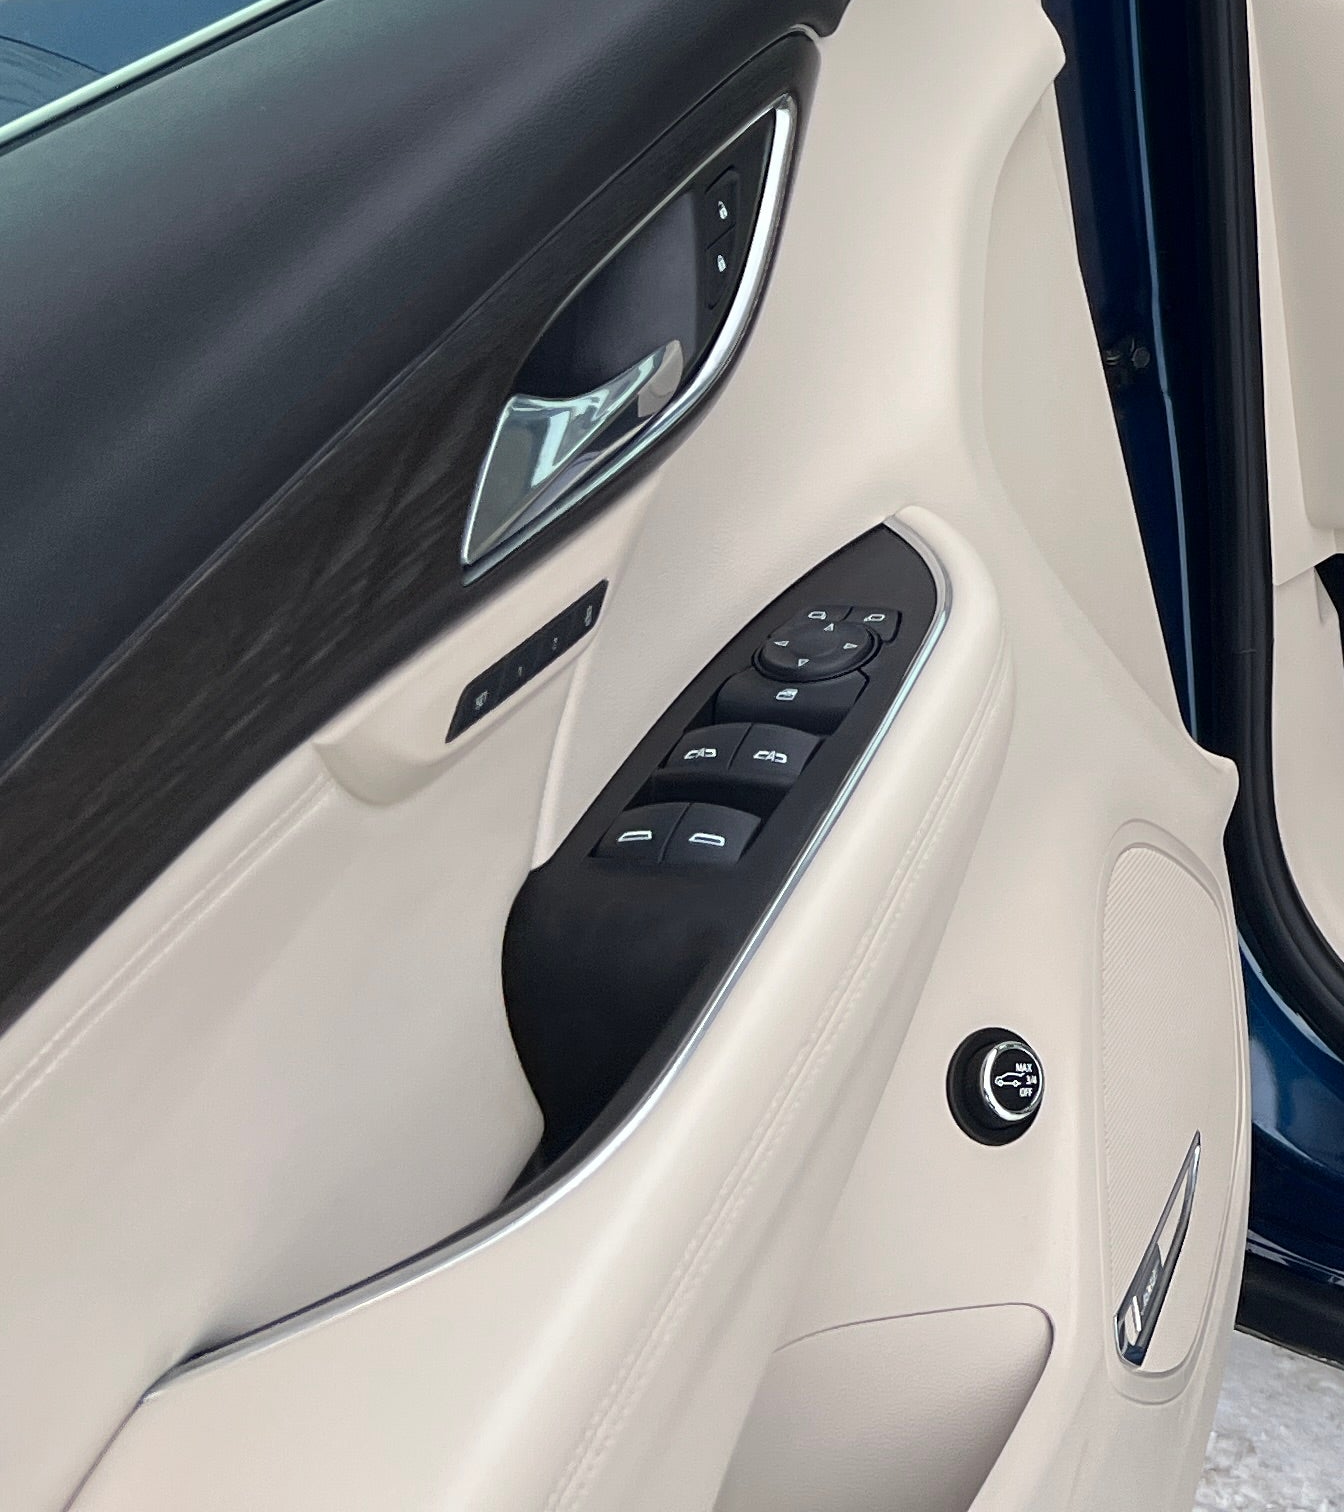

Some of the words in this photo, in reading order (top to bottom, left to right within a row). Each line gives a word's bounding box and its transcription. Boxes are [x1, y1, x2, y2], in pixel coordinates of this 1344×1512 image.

[1015, 1062, 1033, 1073] MAX
[1026, 1075, 1038, 1085] 3/4
[1019, 1087, 1033, 1097] OFF
